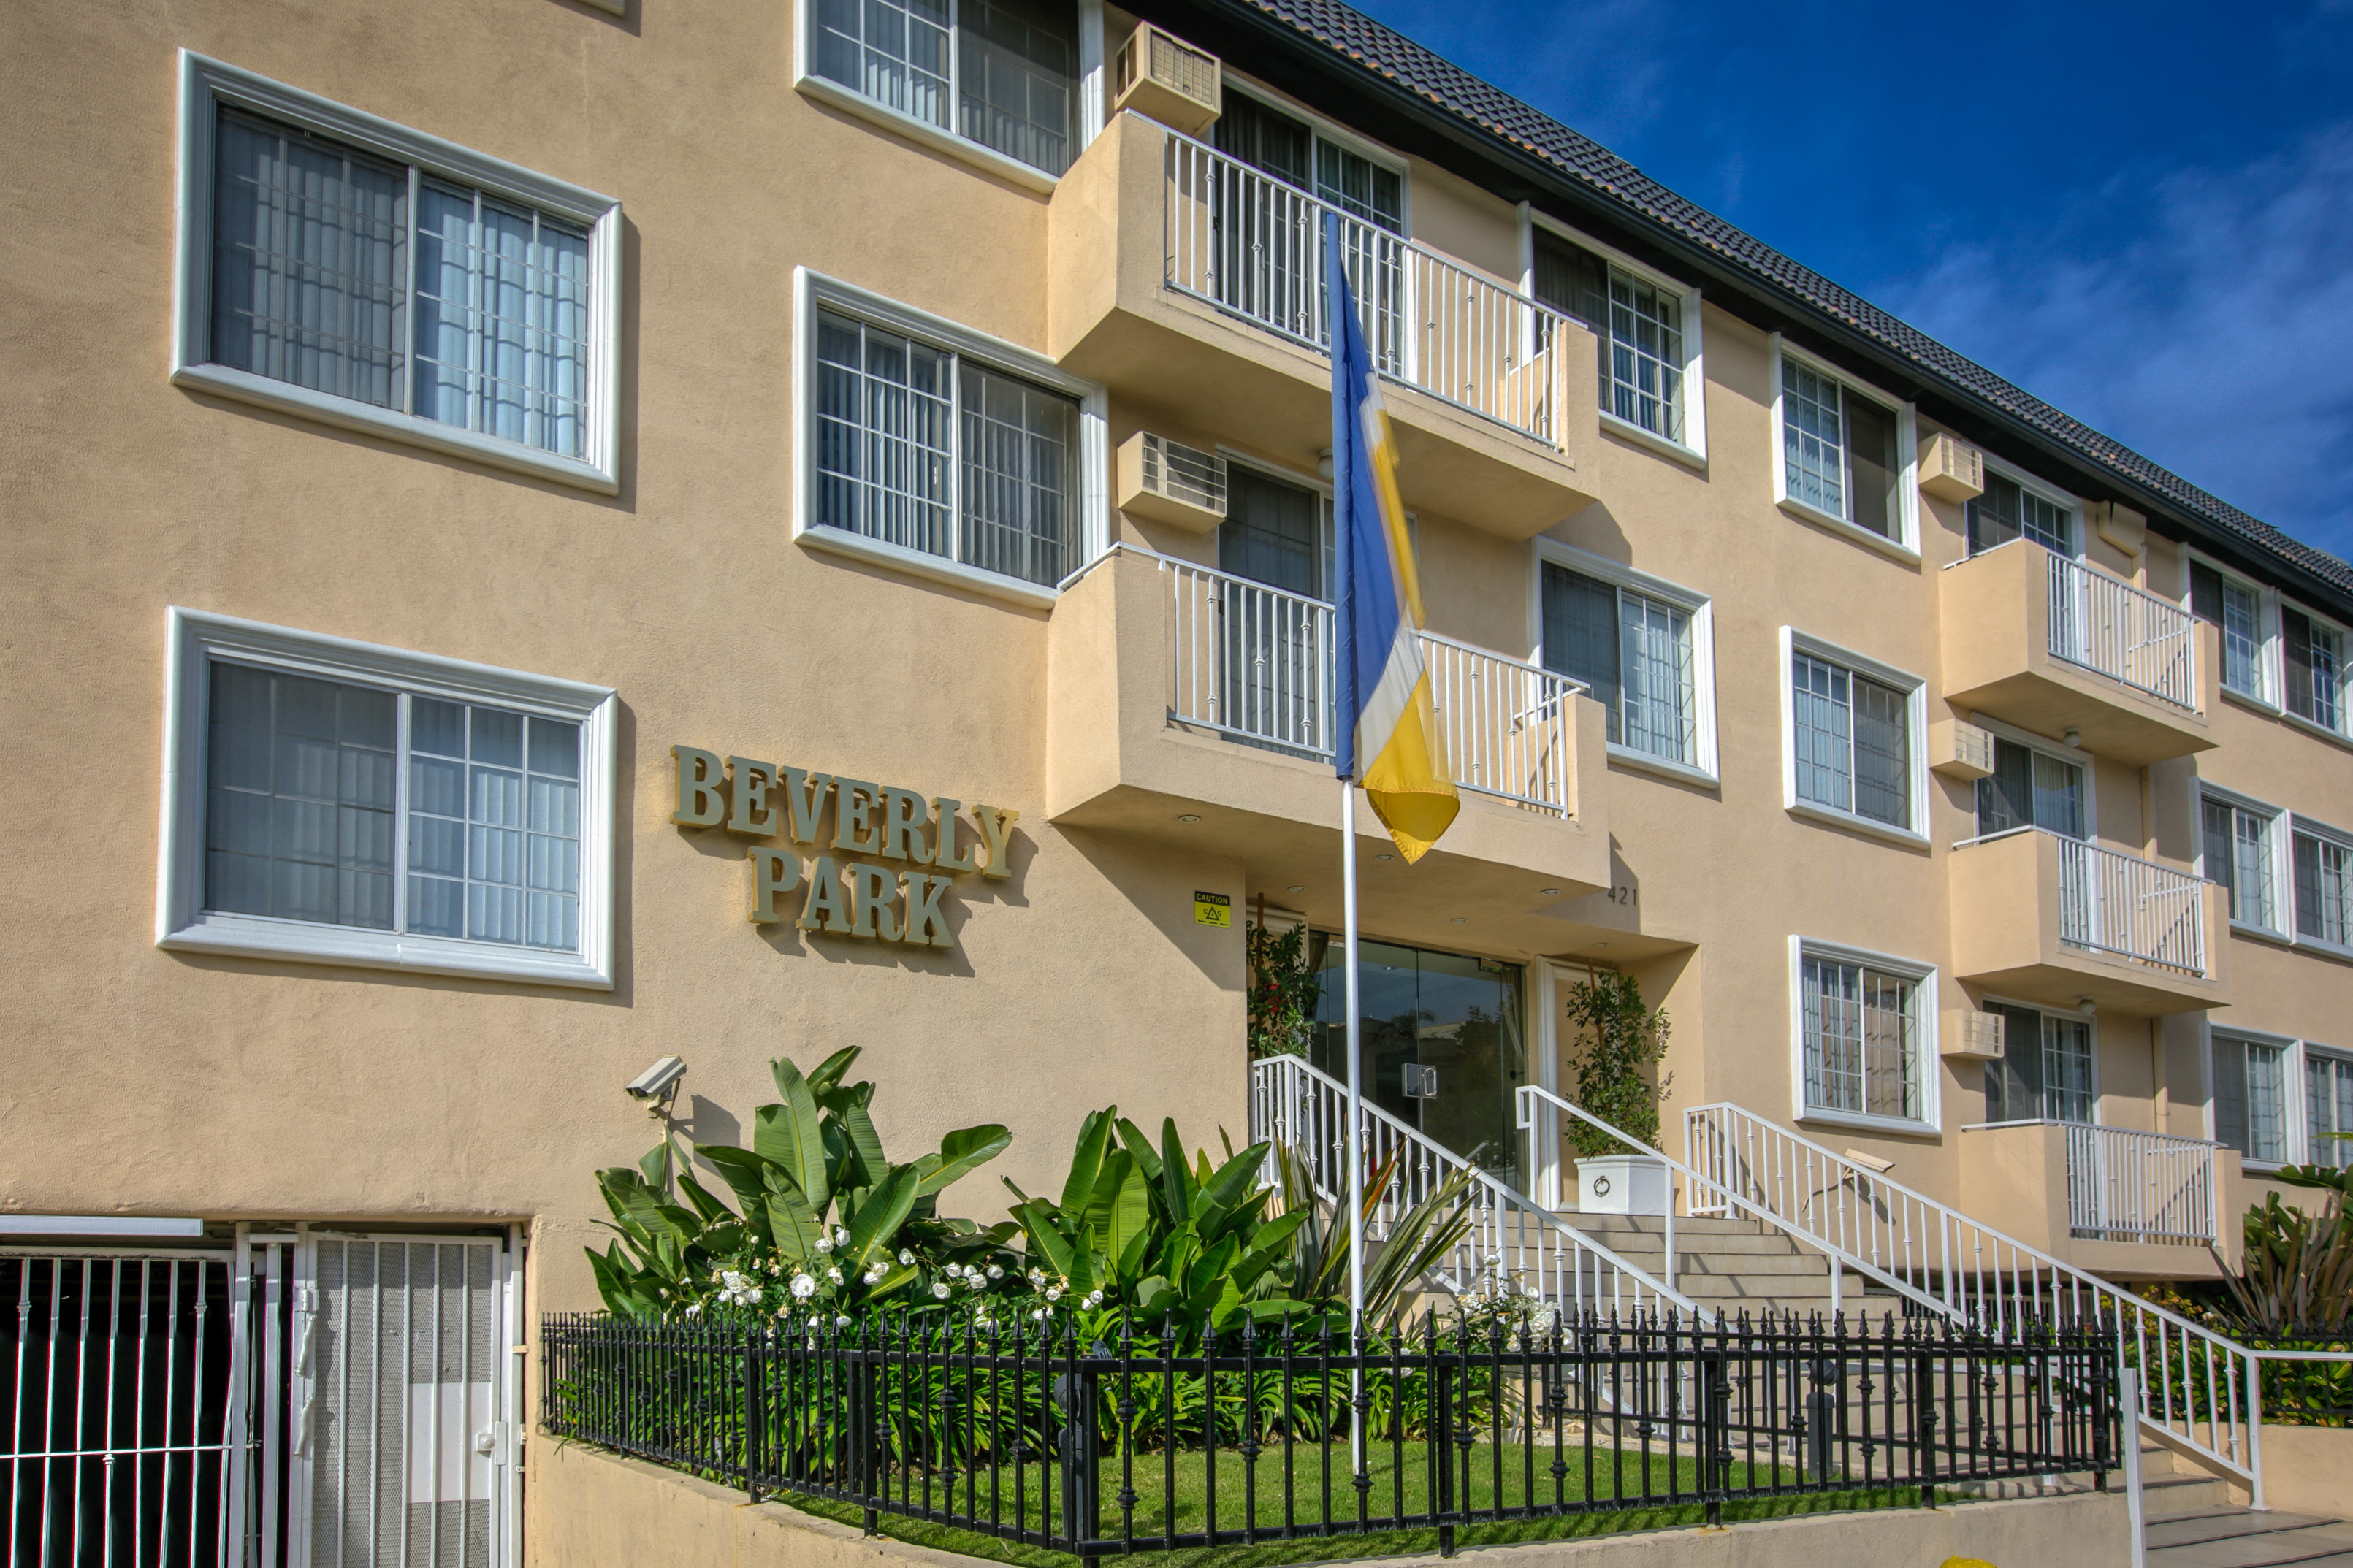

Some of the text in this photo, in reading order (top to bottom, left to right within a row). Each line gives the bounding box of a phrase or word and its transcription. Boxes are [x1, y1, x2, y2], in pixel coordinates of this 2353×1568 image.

[669, 744, 1019, 880] BEVERLY
[747, 846, 955, 949] PARK
[1196, 893, 1228, 905] CAUTION
[1607, 885, 1637, 906] 421
